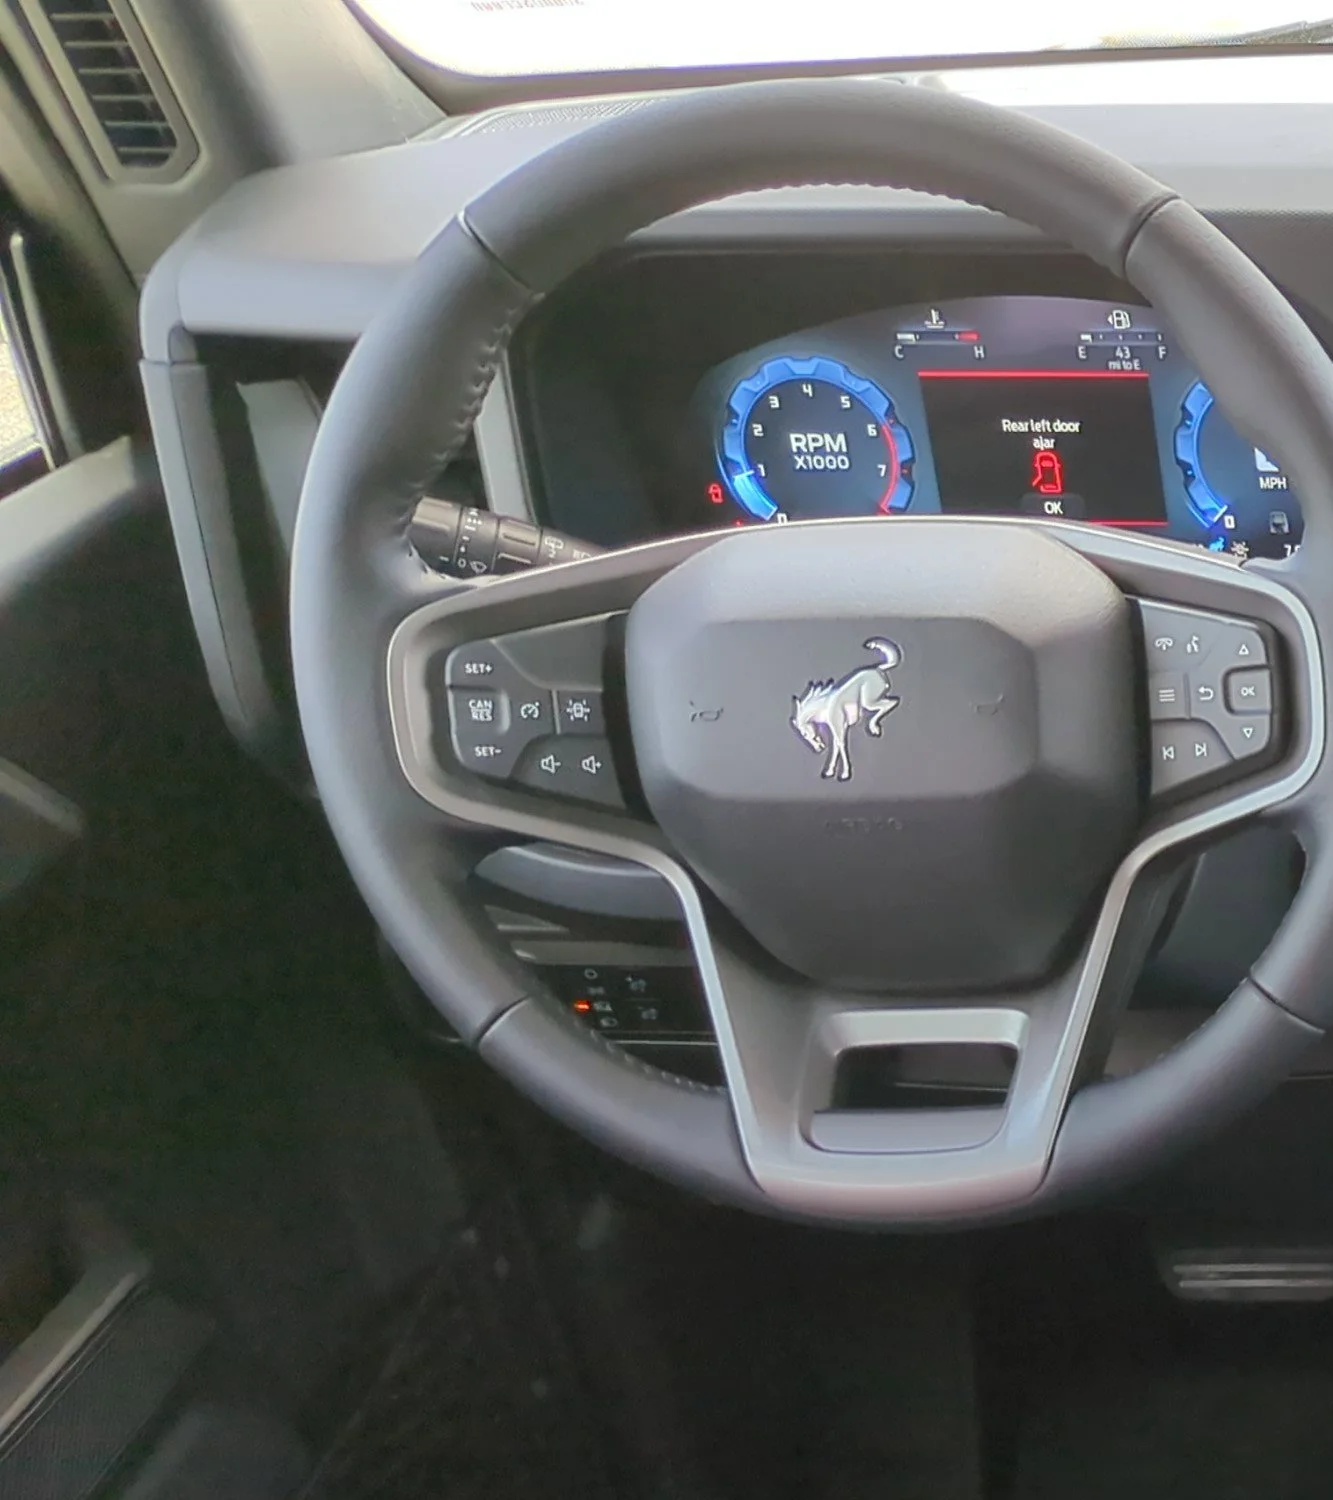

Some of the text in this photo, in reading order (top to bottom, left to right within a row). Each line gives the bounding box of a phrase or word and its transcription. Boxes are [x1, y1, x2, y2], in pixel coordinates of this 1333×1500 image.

[894, 346, 904, 359] C
[974, 347, 984, 359] H
[1078, 347, 1086, 359] E
[1115, 347, 1130, 359] 43
[1158, 347, 1167, 359] F
[802, 384, 813, 397] 4
[769, 396, 779, 408] 3
[840, 396, 850, 408] 5
[752, 424, 763, 436] 2
[867, 424, 877, 436] 6
[1001, 419, 1081, 432] Rear left door
[789, 433, 848, 452] RPM
[1033, 436, 1055, 451] ajar
[795, 455, 849, 470] X1000
[758, 464, 766, 477] 1
[877, 465, 887, 477] 7
[1259, 477, 1287, 489] MPH
[1044, 501, 1063, 514] OK
[1224, 515, 1236, 529] 0
[1241, 686, 1256, 696] OK
[468, 700, 493, 709] CAN
[472, 711, 493, 721] RES
